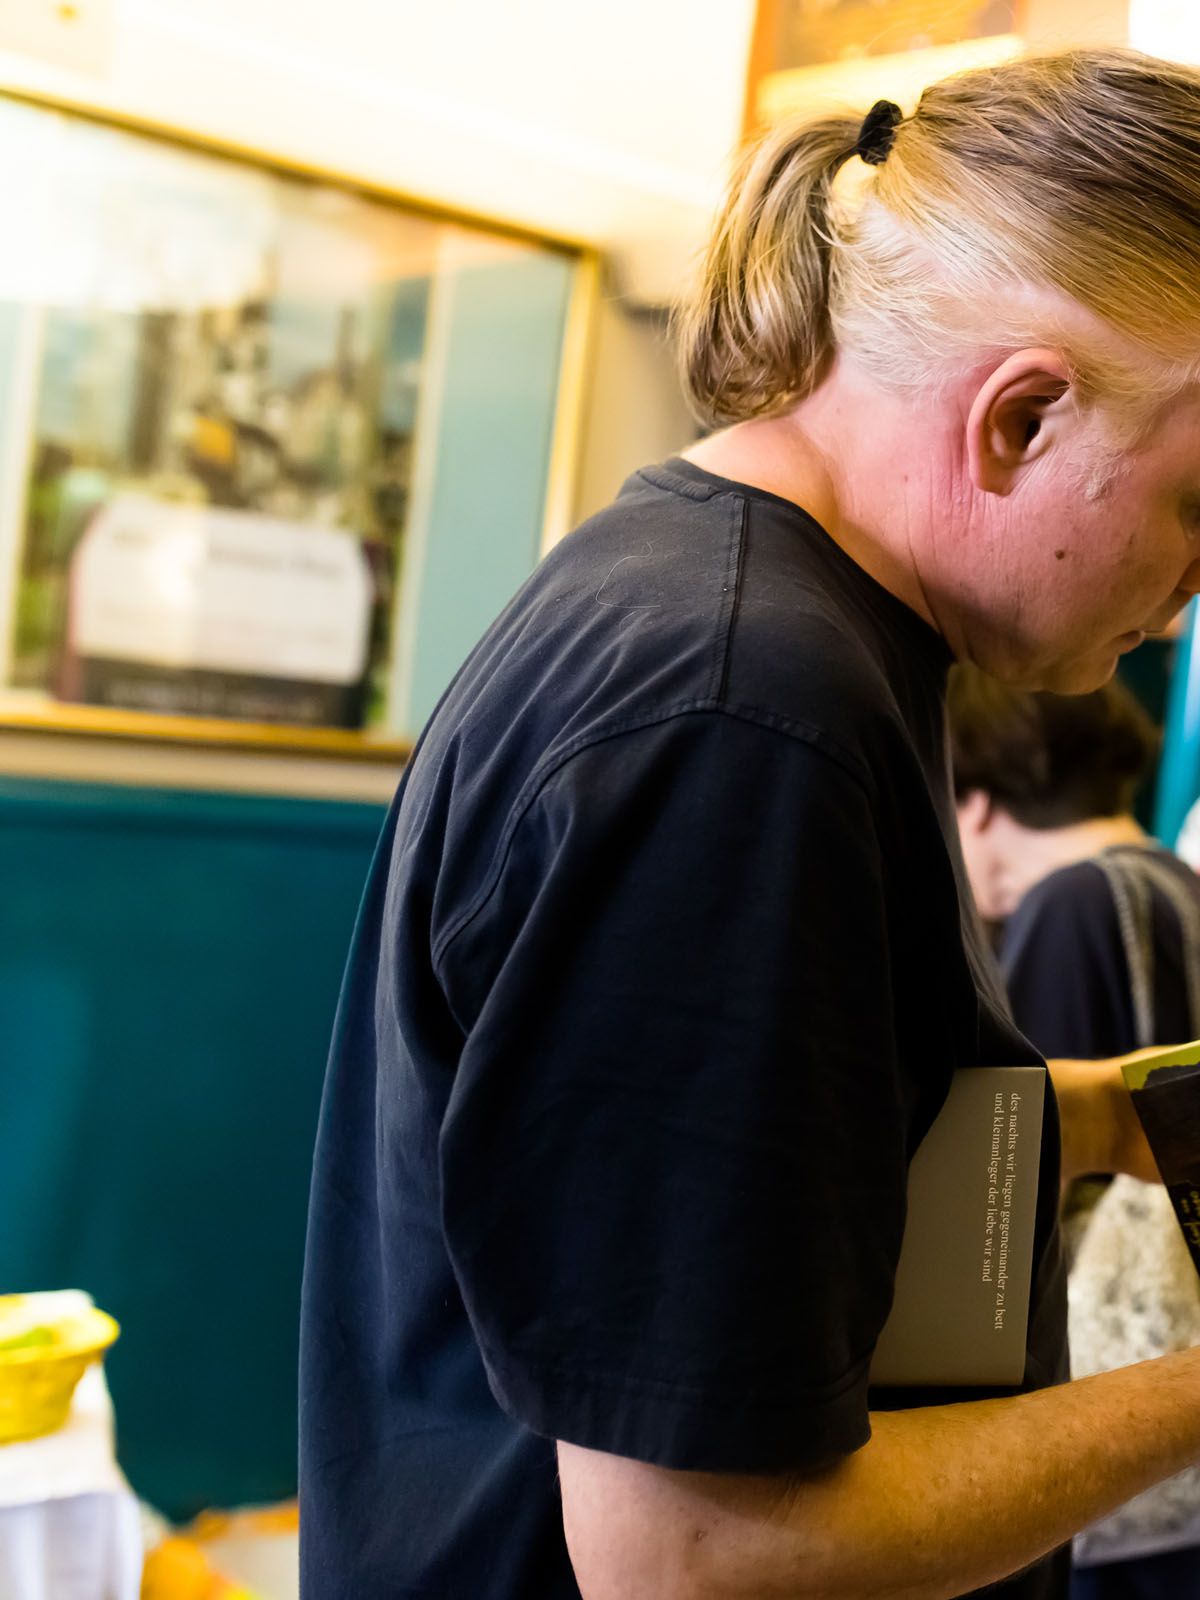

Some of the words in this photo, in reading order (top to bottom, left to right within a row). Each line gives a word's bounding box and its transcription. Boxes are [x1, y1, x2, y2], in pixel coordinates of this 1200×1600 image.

[994, 1092, 1005, 1114] und
[1010, 1092, 1022, 1112] des
[1007, 1114, 1019, 1150] nachts
[987, 1116, 1005, 1185] kleinanleger
[1006, 1152, 1017, 1172] wir
[987, 1187, 999, 1206] der
[1001, 1174, 1016, 1208] liegen
[985, 1208, 998, 1235] liebe
[983, 1237, 996, 1257] wir
[998, 1210, 1012, 1290] gegeneinander
[982, 1259, 994, 1282] sind
[996, 1292, 1005, 1306] zu
[994, 1309, 1006, 1329] bett
